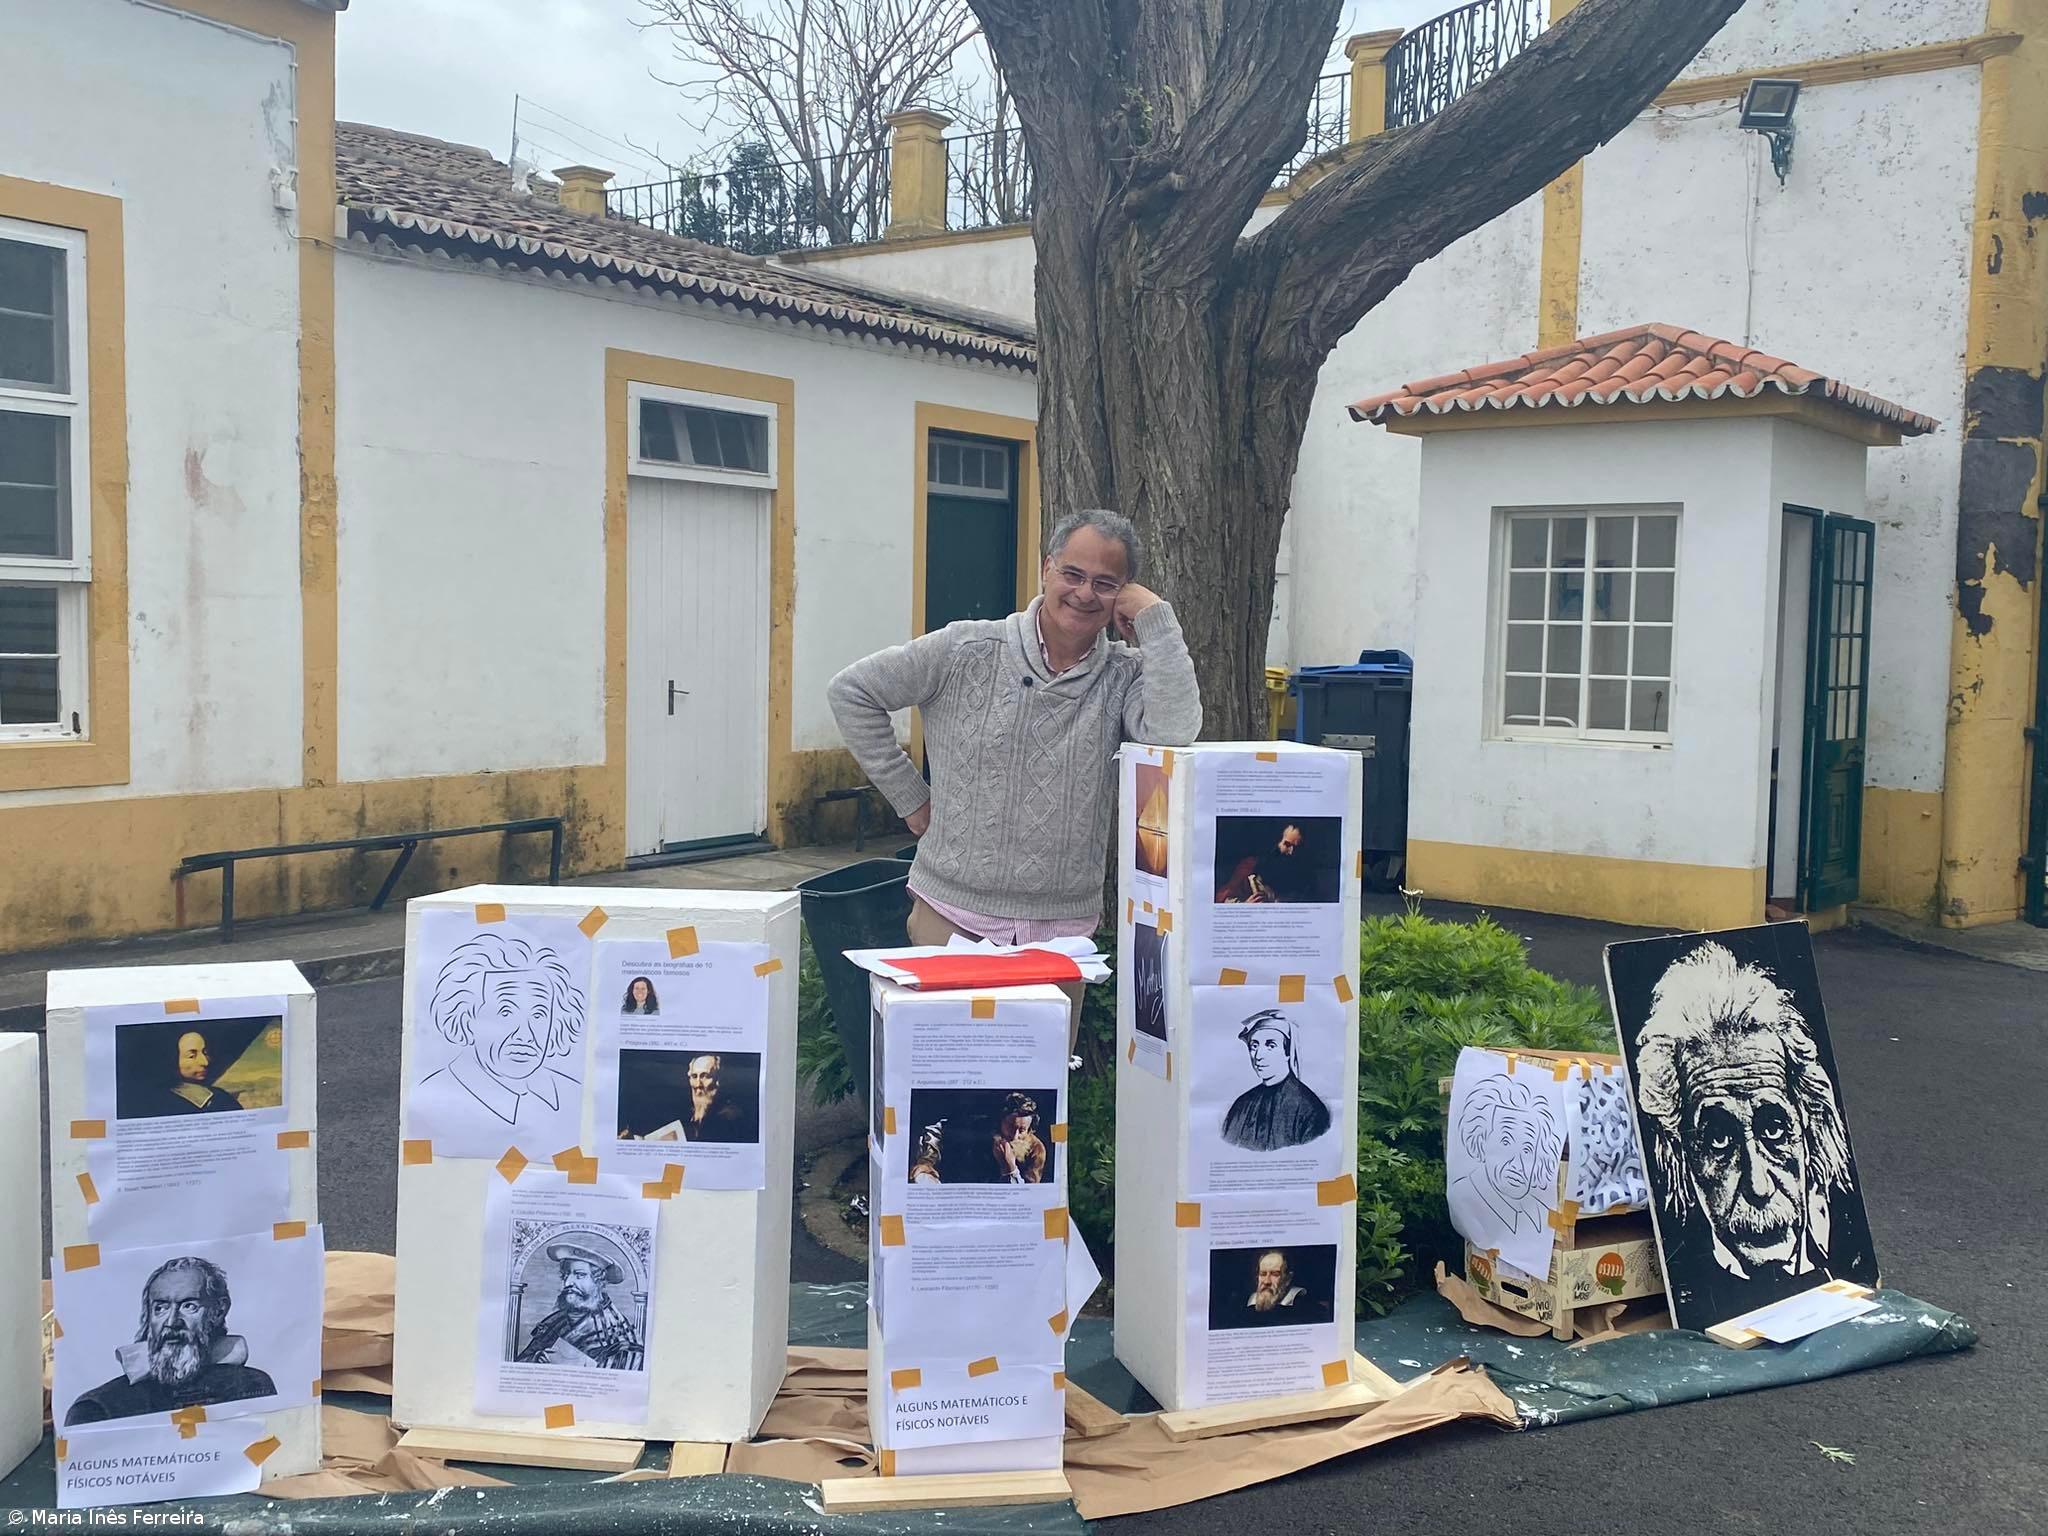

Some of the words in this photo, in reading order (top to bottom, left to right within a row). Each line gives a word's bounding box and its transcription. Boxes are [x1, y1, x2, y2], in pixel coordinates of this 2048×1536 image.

[896, 1400, 938, 1413] ALGUNS
[940, 1395, 1019, 1410] MATEMÁTICOS
[1023, 1395, 1028, 1405] E
[896, 1418, 935, 1431] FÍSICOS
[938, 1413, 989, 1428] NOTÁVEIS
[68, 1458, 118, 1471] ALGUNS
[121, 1451, 211, 1467] MATEMÁTICOS
[214, 1451, 221, 1461] E
[67, 1475, 113, 1489] FÍSICOS
[116, 1471, 175, 1486] NOTÁVEIS
